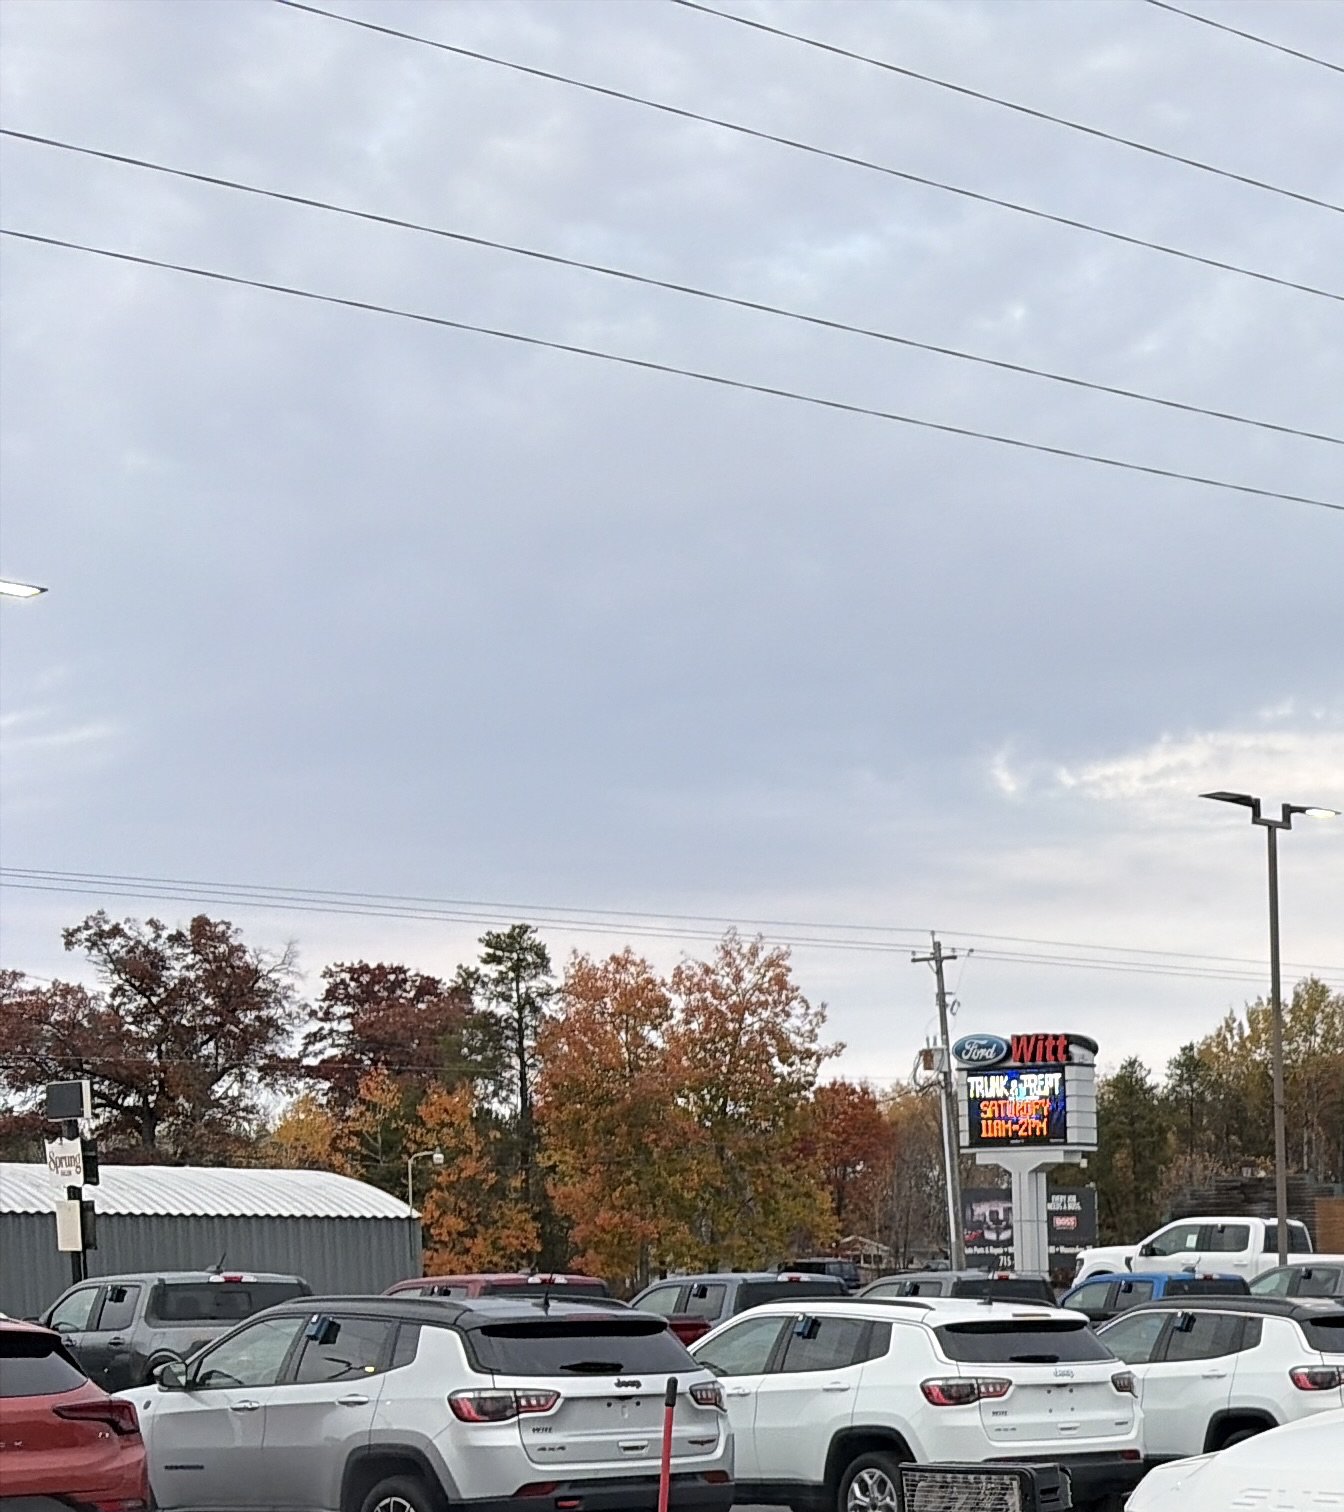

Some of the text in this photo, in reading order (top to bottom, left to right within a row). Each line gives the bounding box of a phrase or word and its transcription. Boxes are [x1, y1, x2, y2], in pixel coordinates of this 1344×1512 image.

[961, 1039, 996, 1060] Ford
[1011, 1034, 1067, 1063] Witt
[967, 1075, 1008, 1098] TRUNK
[49, 1151, 82, 1174] Sprung
[614, 1378, 642, 1389] Jeep
